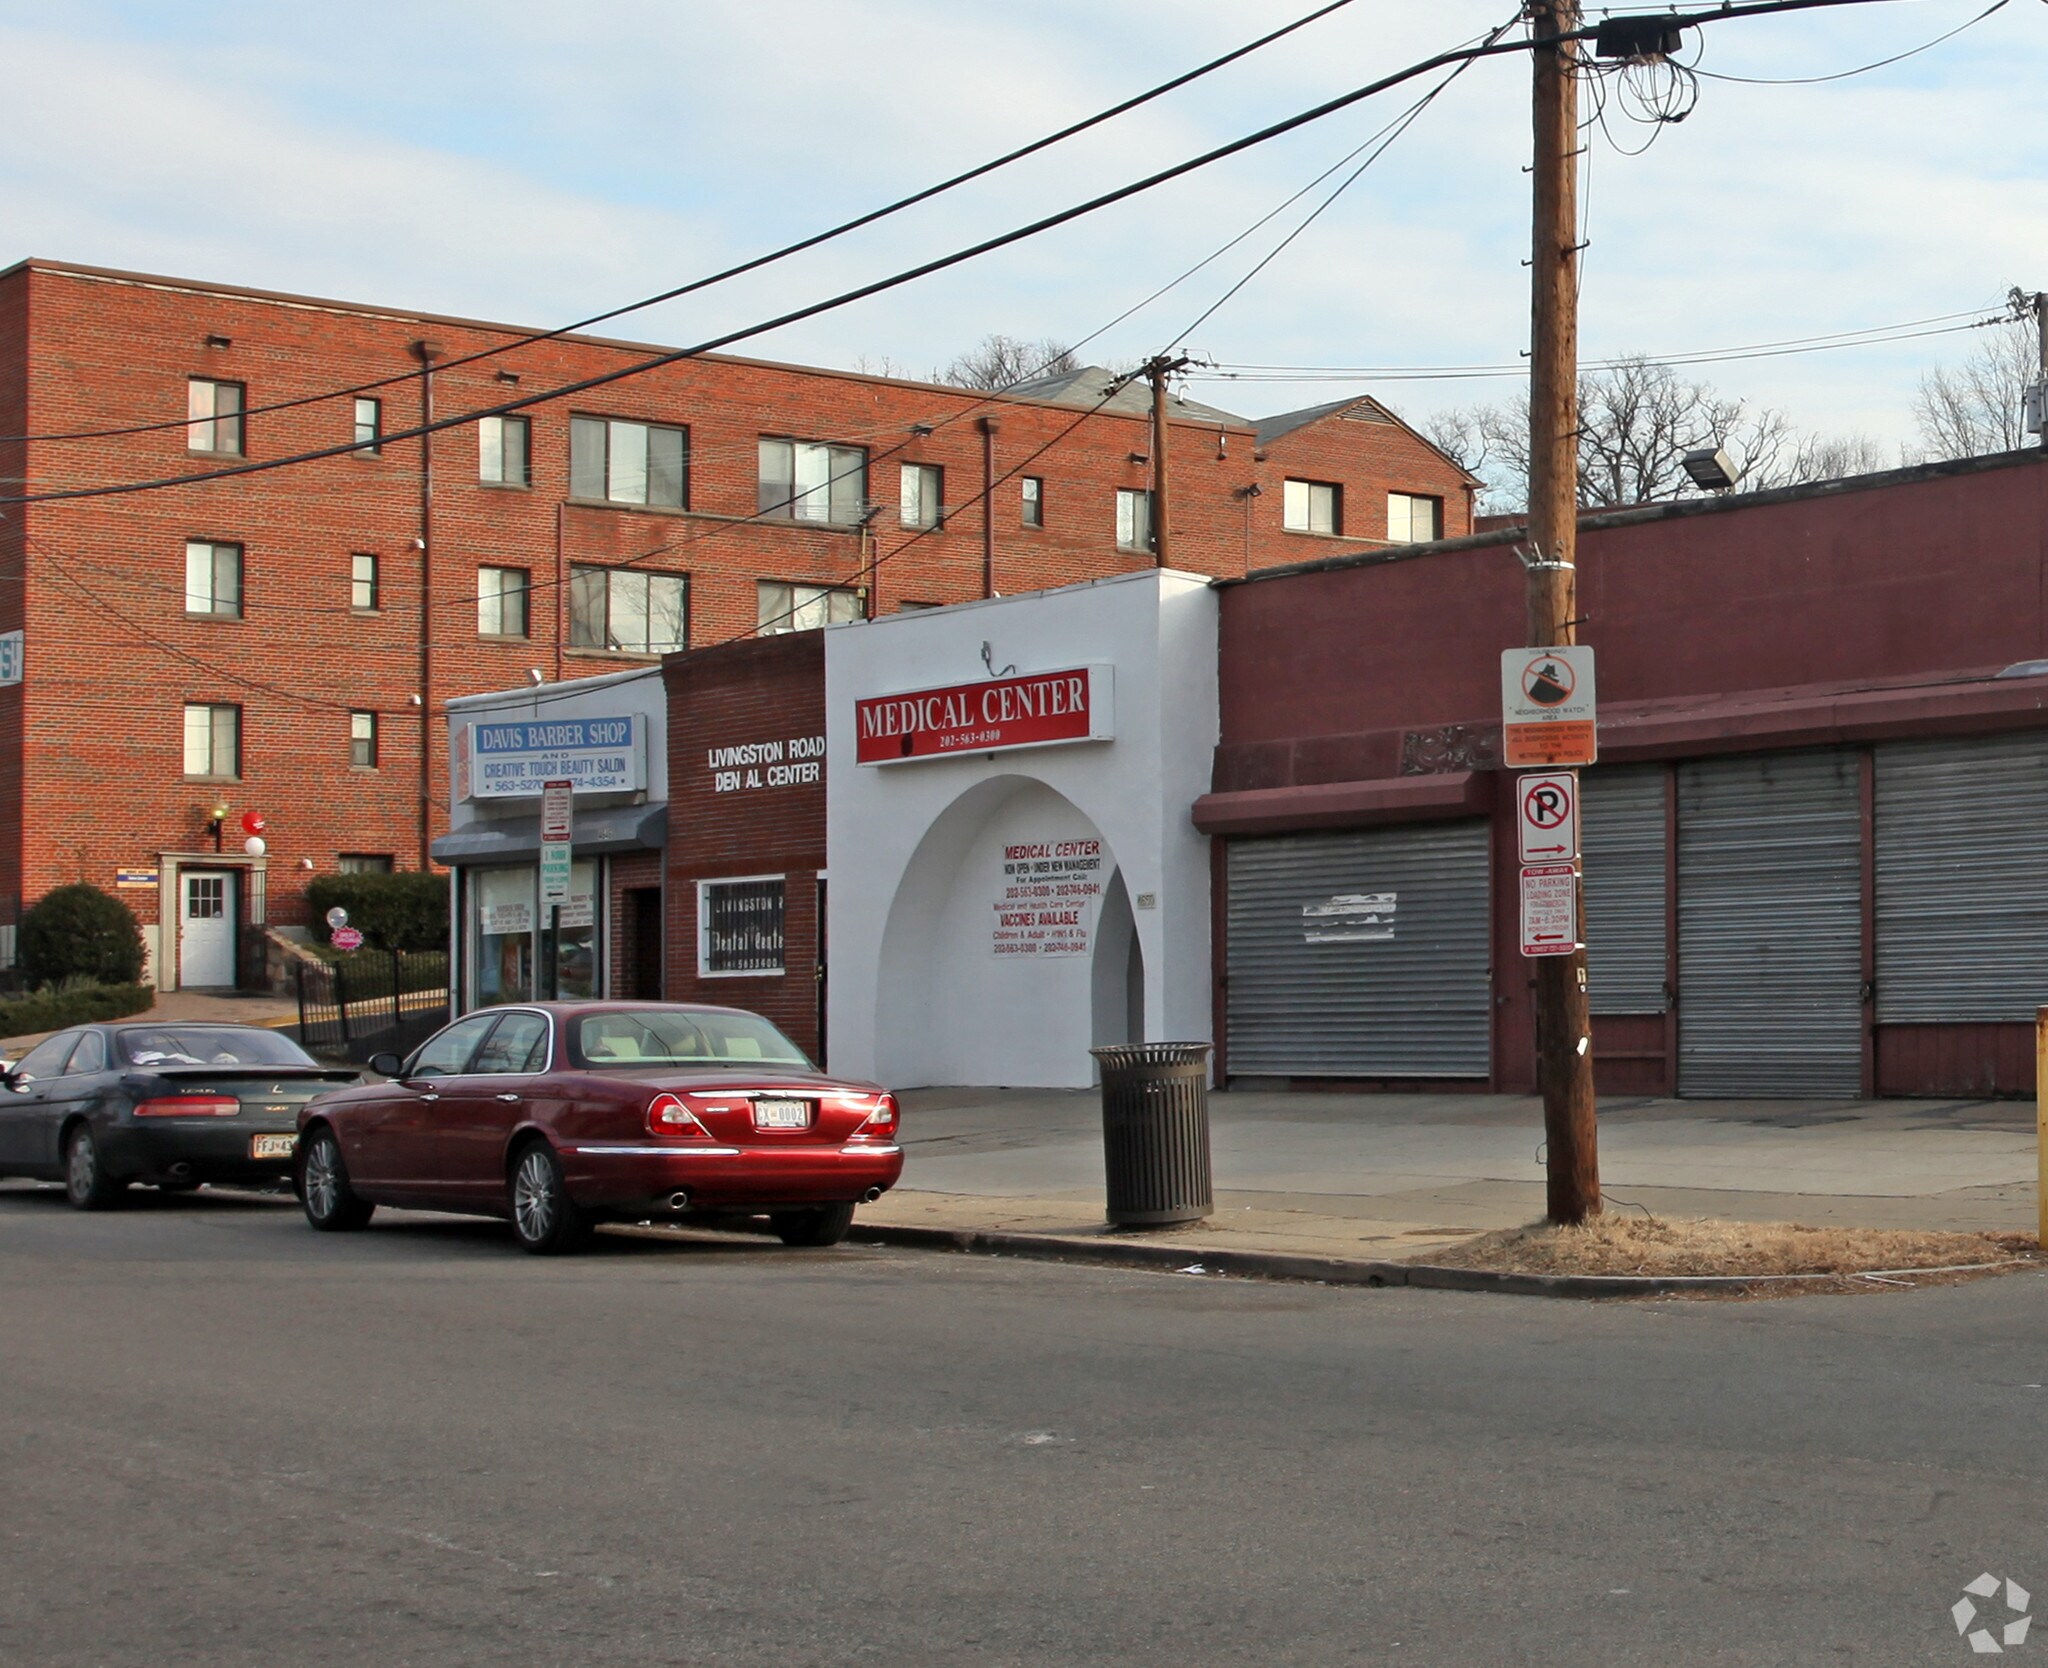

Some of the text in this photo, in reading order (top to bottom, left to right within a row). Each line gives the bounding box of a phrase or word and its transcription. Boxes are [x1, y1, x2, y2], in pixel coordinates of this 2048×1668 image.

[862, 677, 1085, 739] MEDICAL CENTER
[483, 722, 628, 749] DAVIS BARBER SHOP
[541, 752, 569, 760] AND
[708, 736, 825, 769] LIVINGSTON ROAD
[484, 757, 626, 778] CREATIVE TOUCH BEAUTY SALON
[767, 762, 819, 787] CENTER
[567, 776, 617, 788] 74-4354
[1004, 840, 1100, 860] MEDICAL CENTER
[1016, 862, 1030, 875] OPEN
[1033, 861, 1050, 873] UNDER
[1051, 860, 1063, 872] NEW
[1064, 858, 1101, 871] MANAGEMENT
[1016, 876, 1027, 884] For
[1029, 874, 1071, 884] Appointment
[1525, 877, 1569, 889] NO PARKING
[1000, 911, 1079, 927] VACCINES AVAILABLE
[779, 1107, 803, 1121] 0002
[255, 1141, 276, 1152] FFJ
